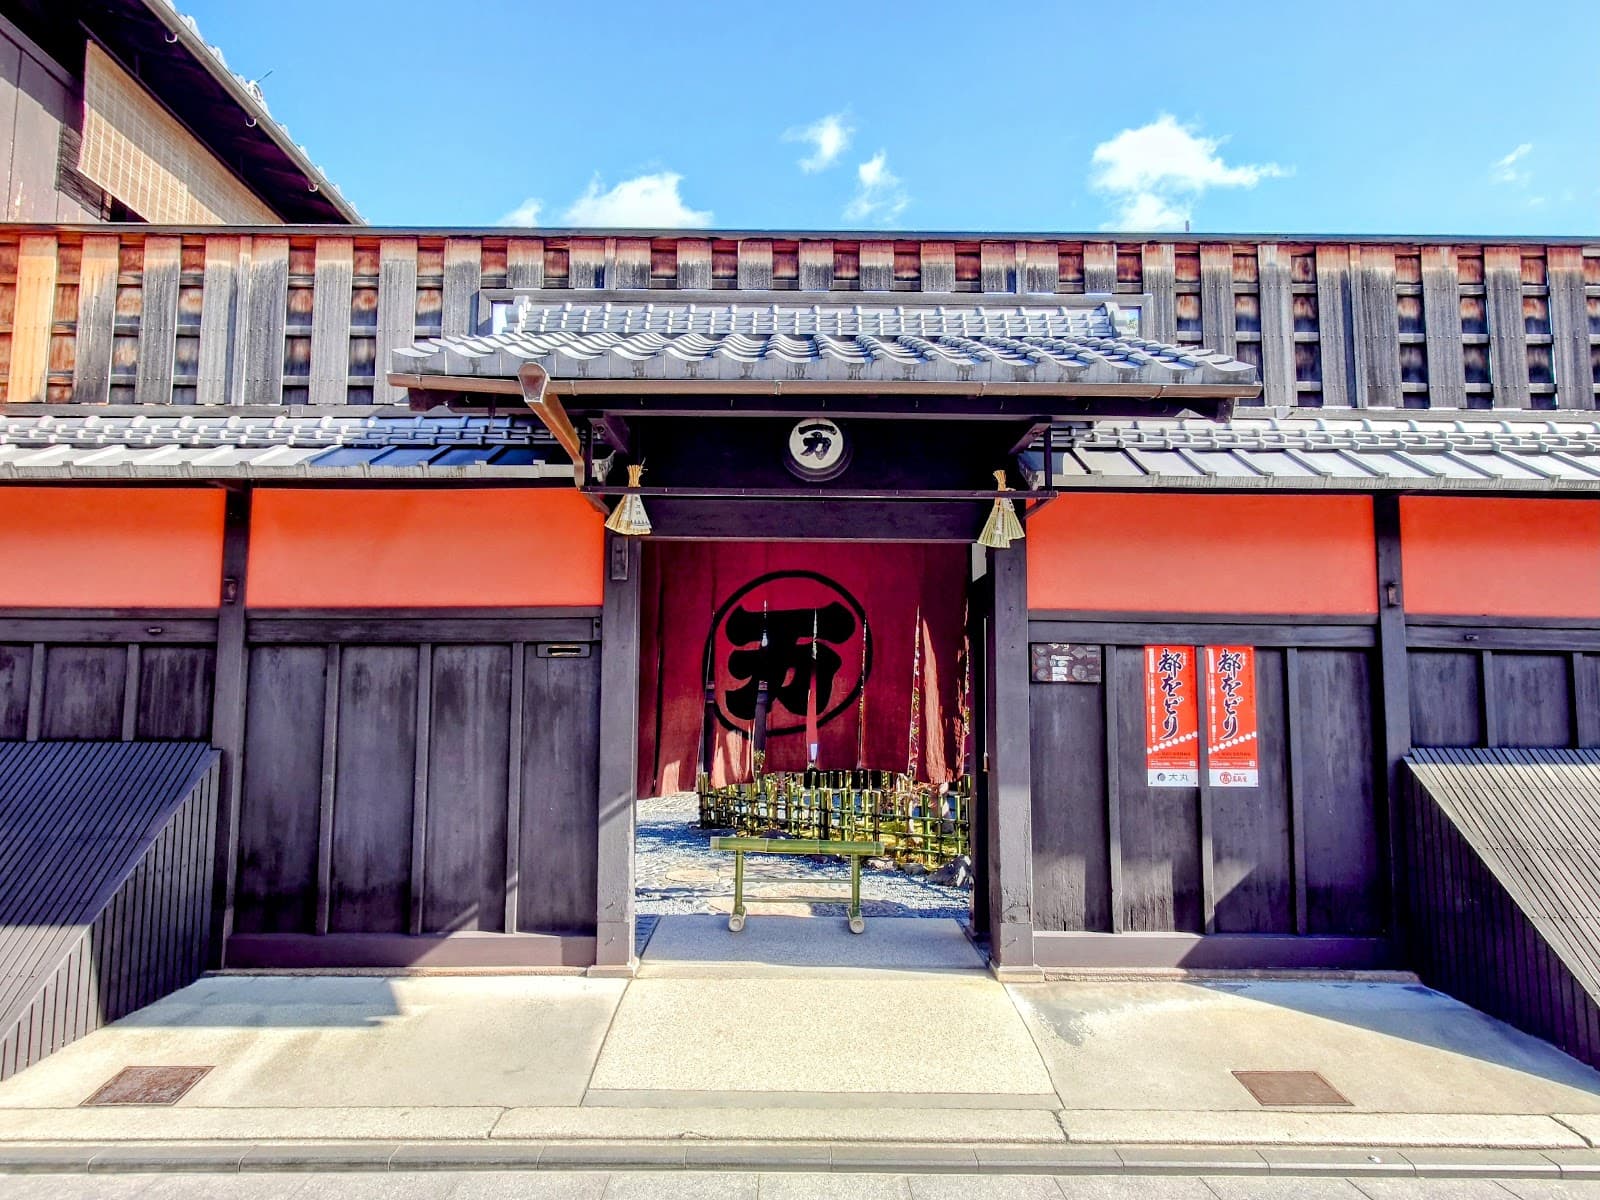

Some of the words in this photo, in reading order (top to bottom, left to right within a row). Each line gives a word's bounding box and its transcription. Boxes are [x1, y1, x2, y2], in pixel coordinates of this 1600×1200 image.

[1158, 648, 1184, 740] 都をどり
[1217, 648, 1243, 740] 都をどり
[1168, 772, 1188, 782] 大丸
